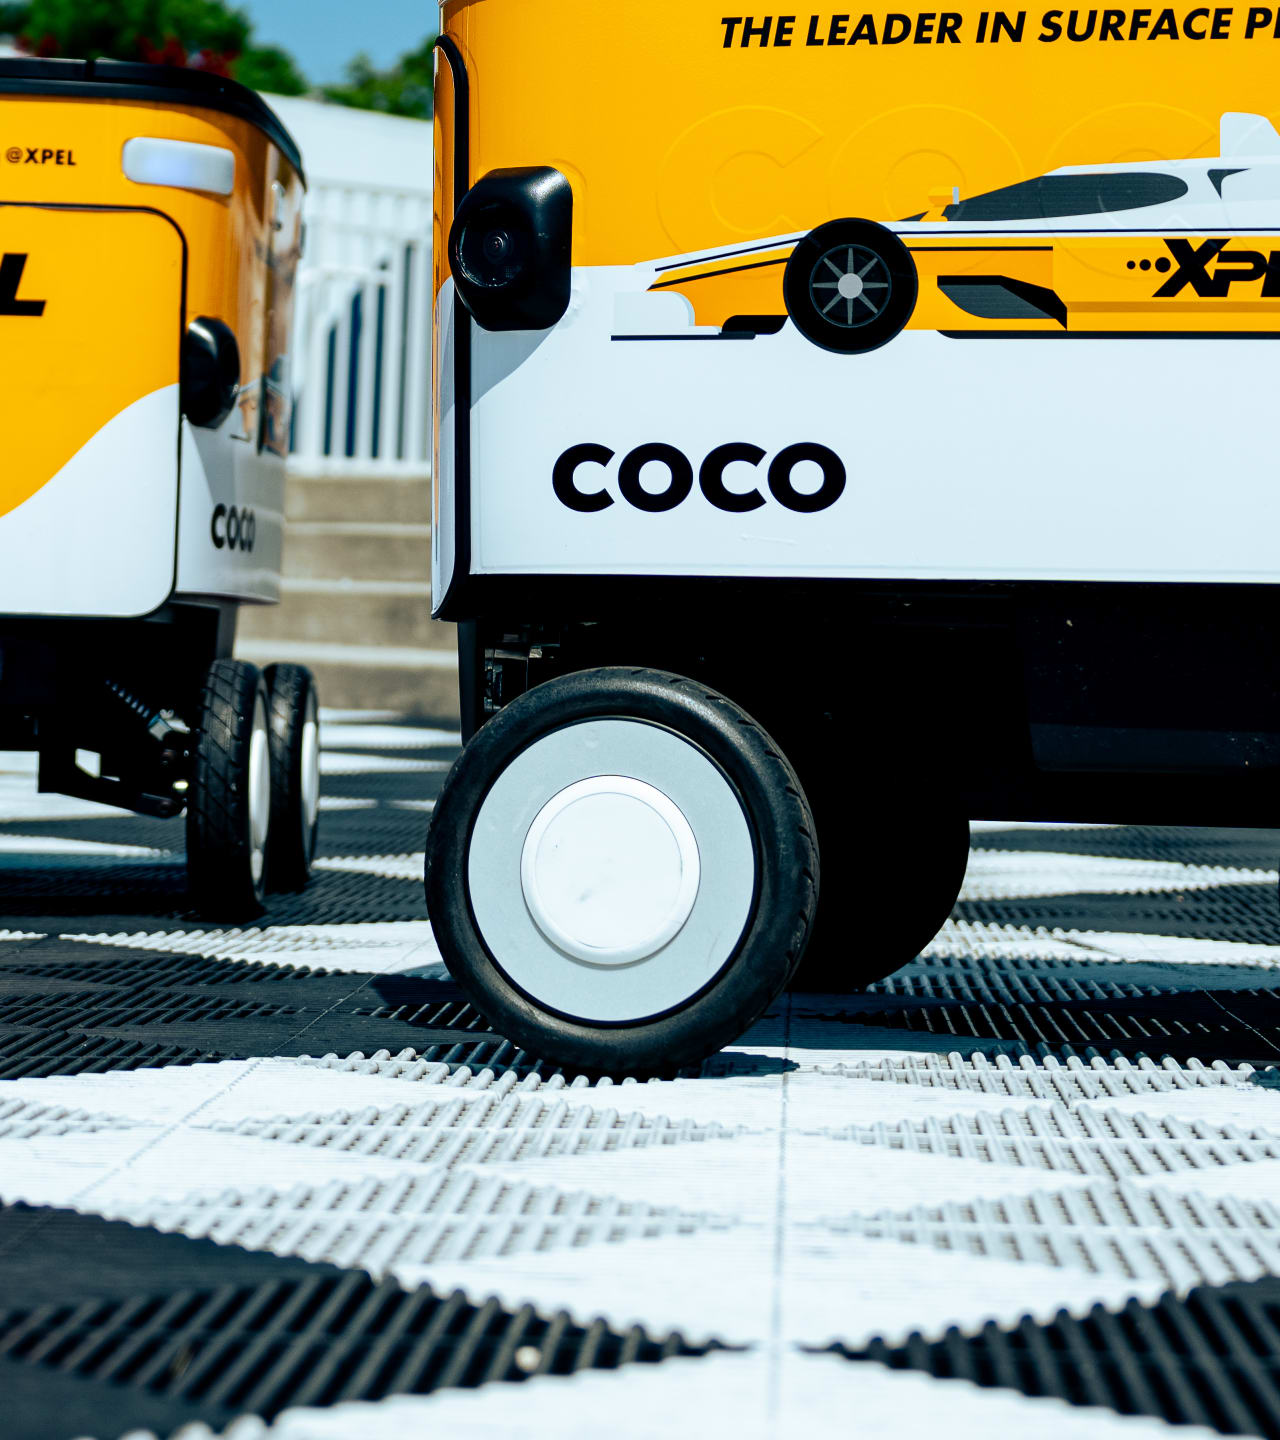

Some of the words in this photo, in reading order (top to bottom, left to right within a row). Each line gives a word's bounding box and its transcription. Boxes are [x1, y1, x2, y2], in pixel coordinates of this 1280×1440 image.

[720, 15, 797, 49] THE
[805, 12, 963, 48] LEADER
[975, 10, 1027, 44] IN
[1037, 7, 1234, 43] SURFACE
[6, 147, 77, 167] @XPEL
[552, 442, 847, 513] COCO
